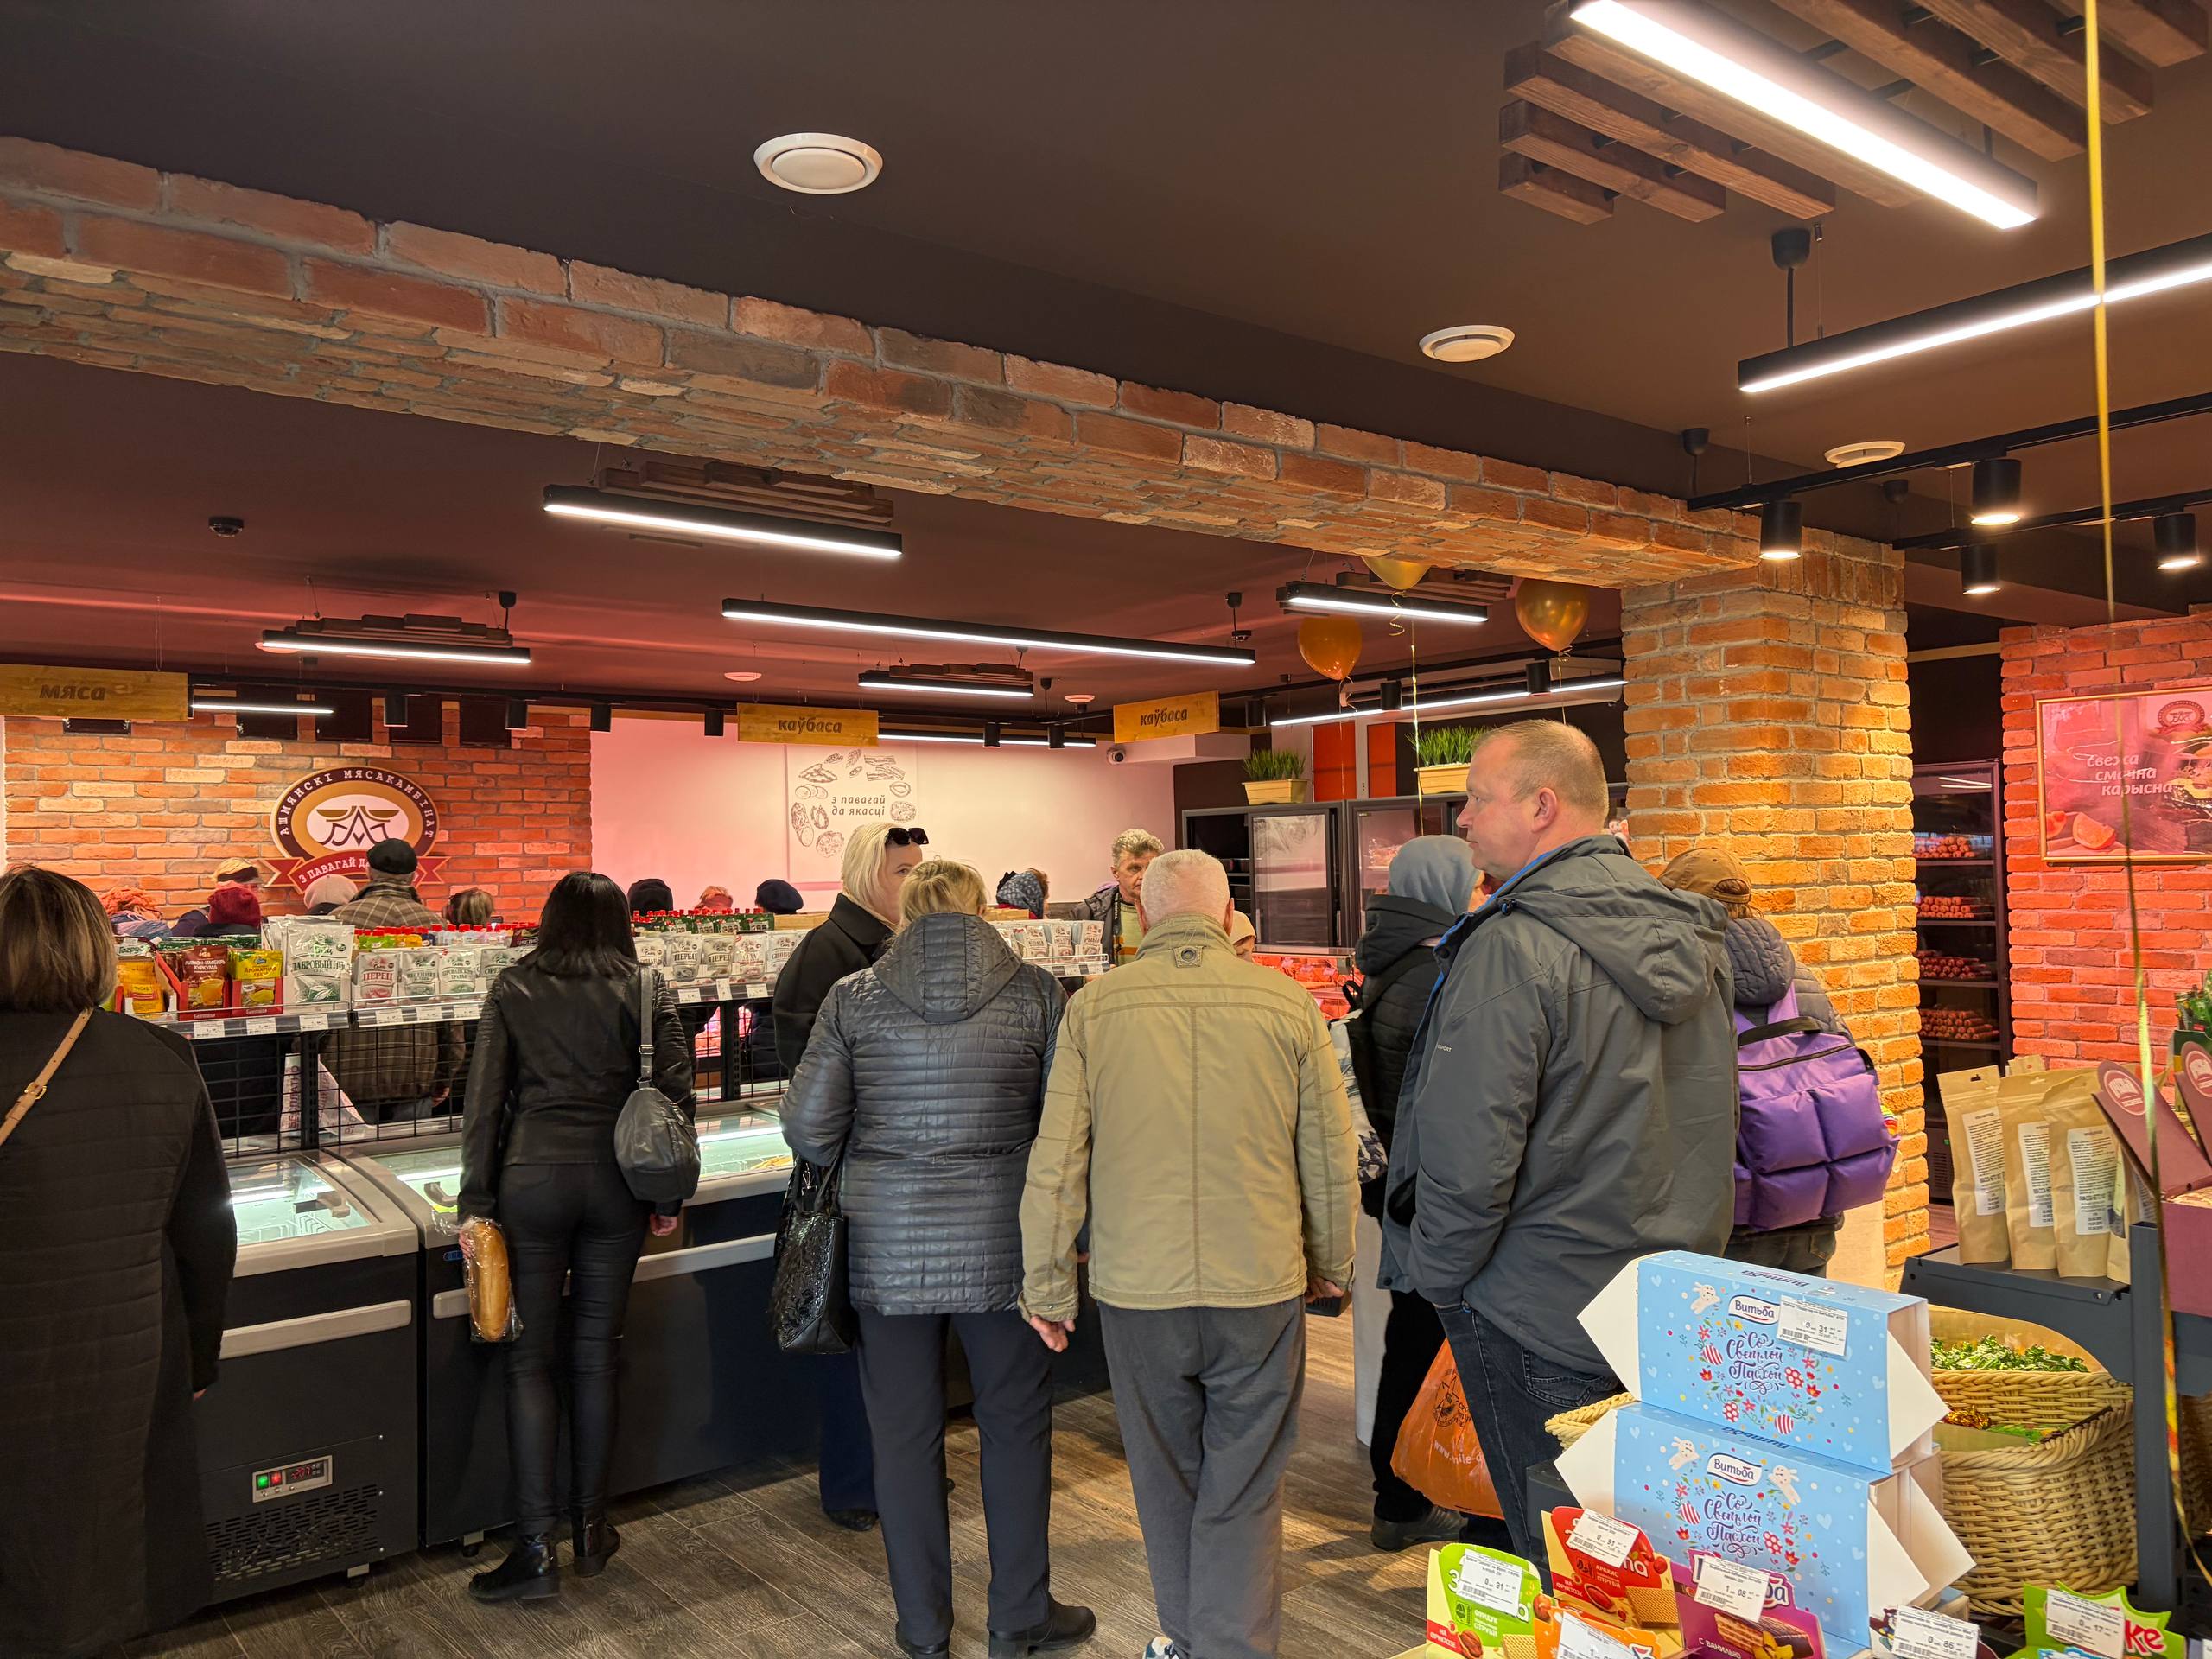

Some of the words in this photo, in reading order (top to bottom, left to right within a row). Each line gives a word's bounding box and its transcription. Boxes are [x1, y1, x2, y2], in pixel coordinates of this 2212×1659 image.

[39, 684, 106, 701] мяса
[779, 717, 842, 734] каўбаса
[1141, 708, 1188, 727] каўбаса
[279, 773, 334, 836] АШМЯНСКІ
[344, 769, 435, 838] МЯСАКАМБІНАТ
[831, 796, 837, 804] з
[841, 795, 886, 804] павагай
[831, 807, 844, 817] да
[849, 806, 886, 818] якасці
[298, 874, 308, 884] З
[307, 856, 357, 880] ПАВАГАЙ
[1735, 1300, 1775, 1319] Витьба
[1818, 1325, 1828, 1333] 31
[1747, 1332, 1767, 1349] Со
[1726, 1339, 1783, 1363] Светлой
[1728, 1360, 1783, 1381] Пасхой
[1713, 1458, 1754, 1480] Витьба
[1726, 1492, 1746, 1510] Со
[1704, 1498, 1762, 1527] Светлой
[1706, 1521, 1760, 1545] Пасхой
[1606, 1538, 1616, 1547] 91
[1595, 1564, 1619, 1578] АРАХИС
[1496, 1580, 1503, 1591] 91
[1738, 1588, 1747, 1598] 08
